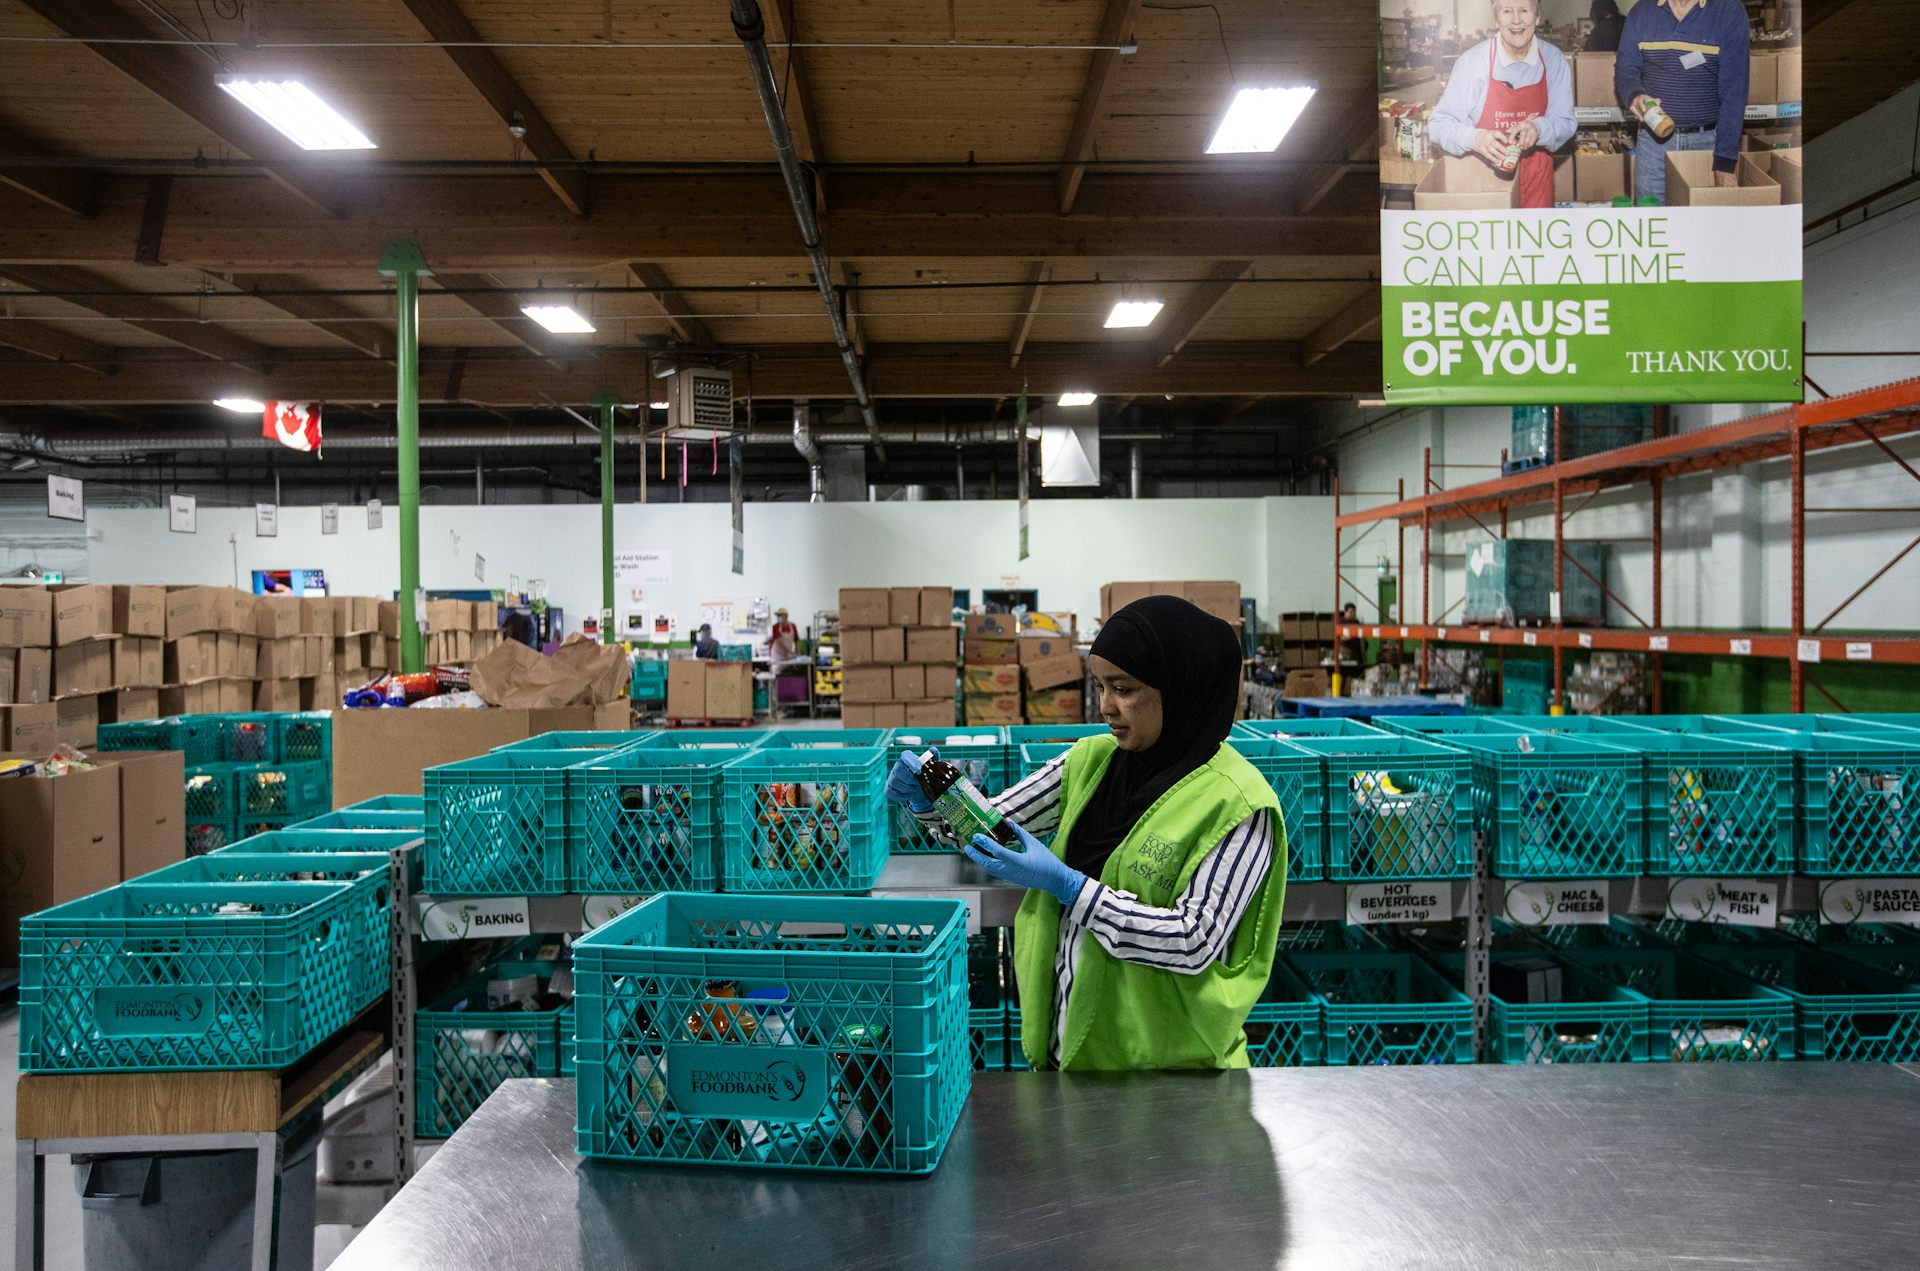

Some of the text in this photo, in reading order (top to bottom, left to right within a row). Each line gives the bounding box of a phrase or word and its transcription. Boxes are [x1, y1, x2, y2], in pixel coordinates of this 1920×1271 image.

[1402, 217, 1669, 251] SORTING ONE
[1402, 253, 1687, 287] CAN AT A TIME
[1402, 299, 1610, 338] BECAUSE
[1403, 339, 1577, 376] OF YOU.
[1626, 349, 1793, 373] THANK YOU.
[1144, 835, 1173, 855] FOOD
[1138, 844, 1168, 865] BANK
[1128, 861, 1157, 882] ASK
[1383, 884, 1411, 896] HOT
[1560, 890, 1599, 901] MAC &
[1874, 890, 1919, 900] PASTA
[1360, 896, 1437, 909] BEVERAGES
[1720, 891, 1769, 904] MEAT &
[1557, 902, 1605, 914] CHEESE
[1729, 903, 1760, 915] FISH
[1873, 901, 1920, 911] SAUCE
[474, 911, 524, 927] BAKING
[1368, 909, 1430, 920] (under 1 kg)
[115, 996, 183, 1011] EDMONTON'S
[115, 1006, 181, 1020] FOODBANK
[691, 1070, 778, 1083] EDMONTON'S
[691, 1081, 778, 1095] FOODBANK
